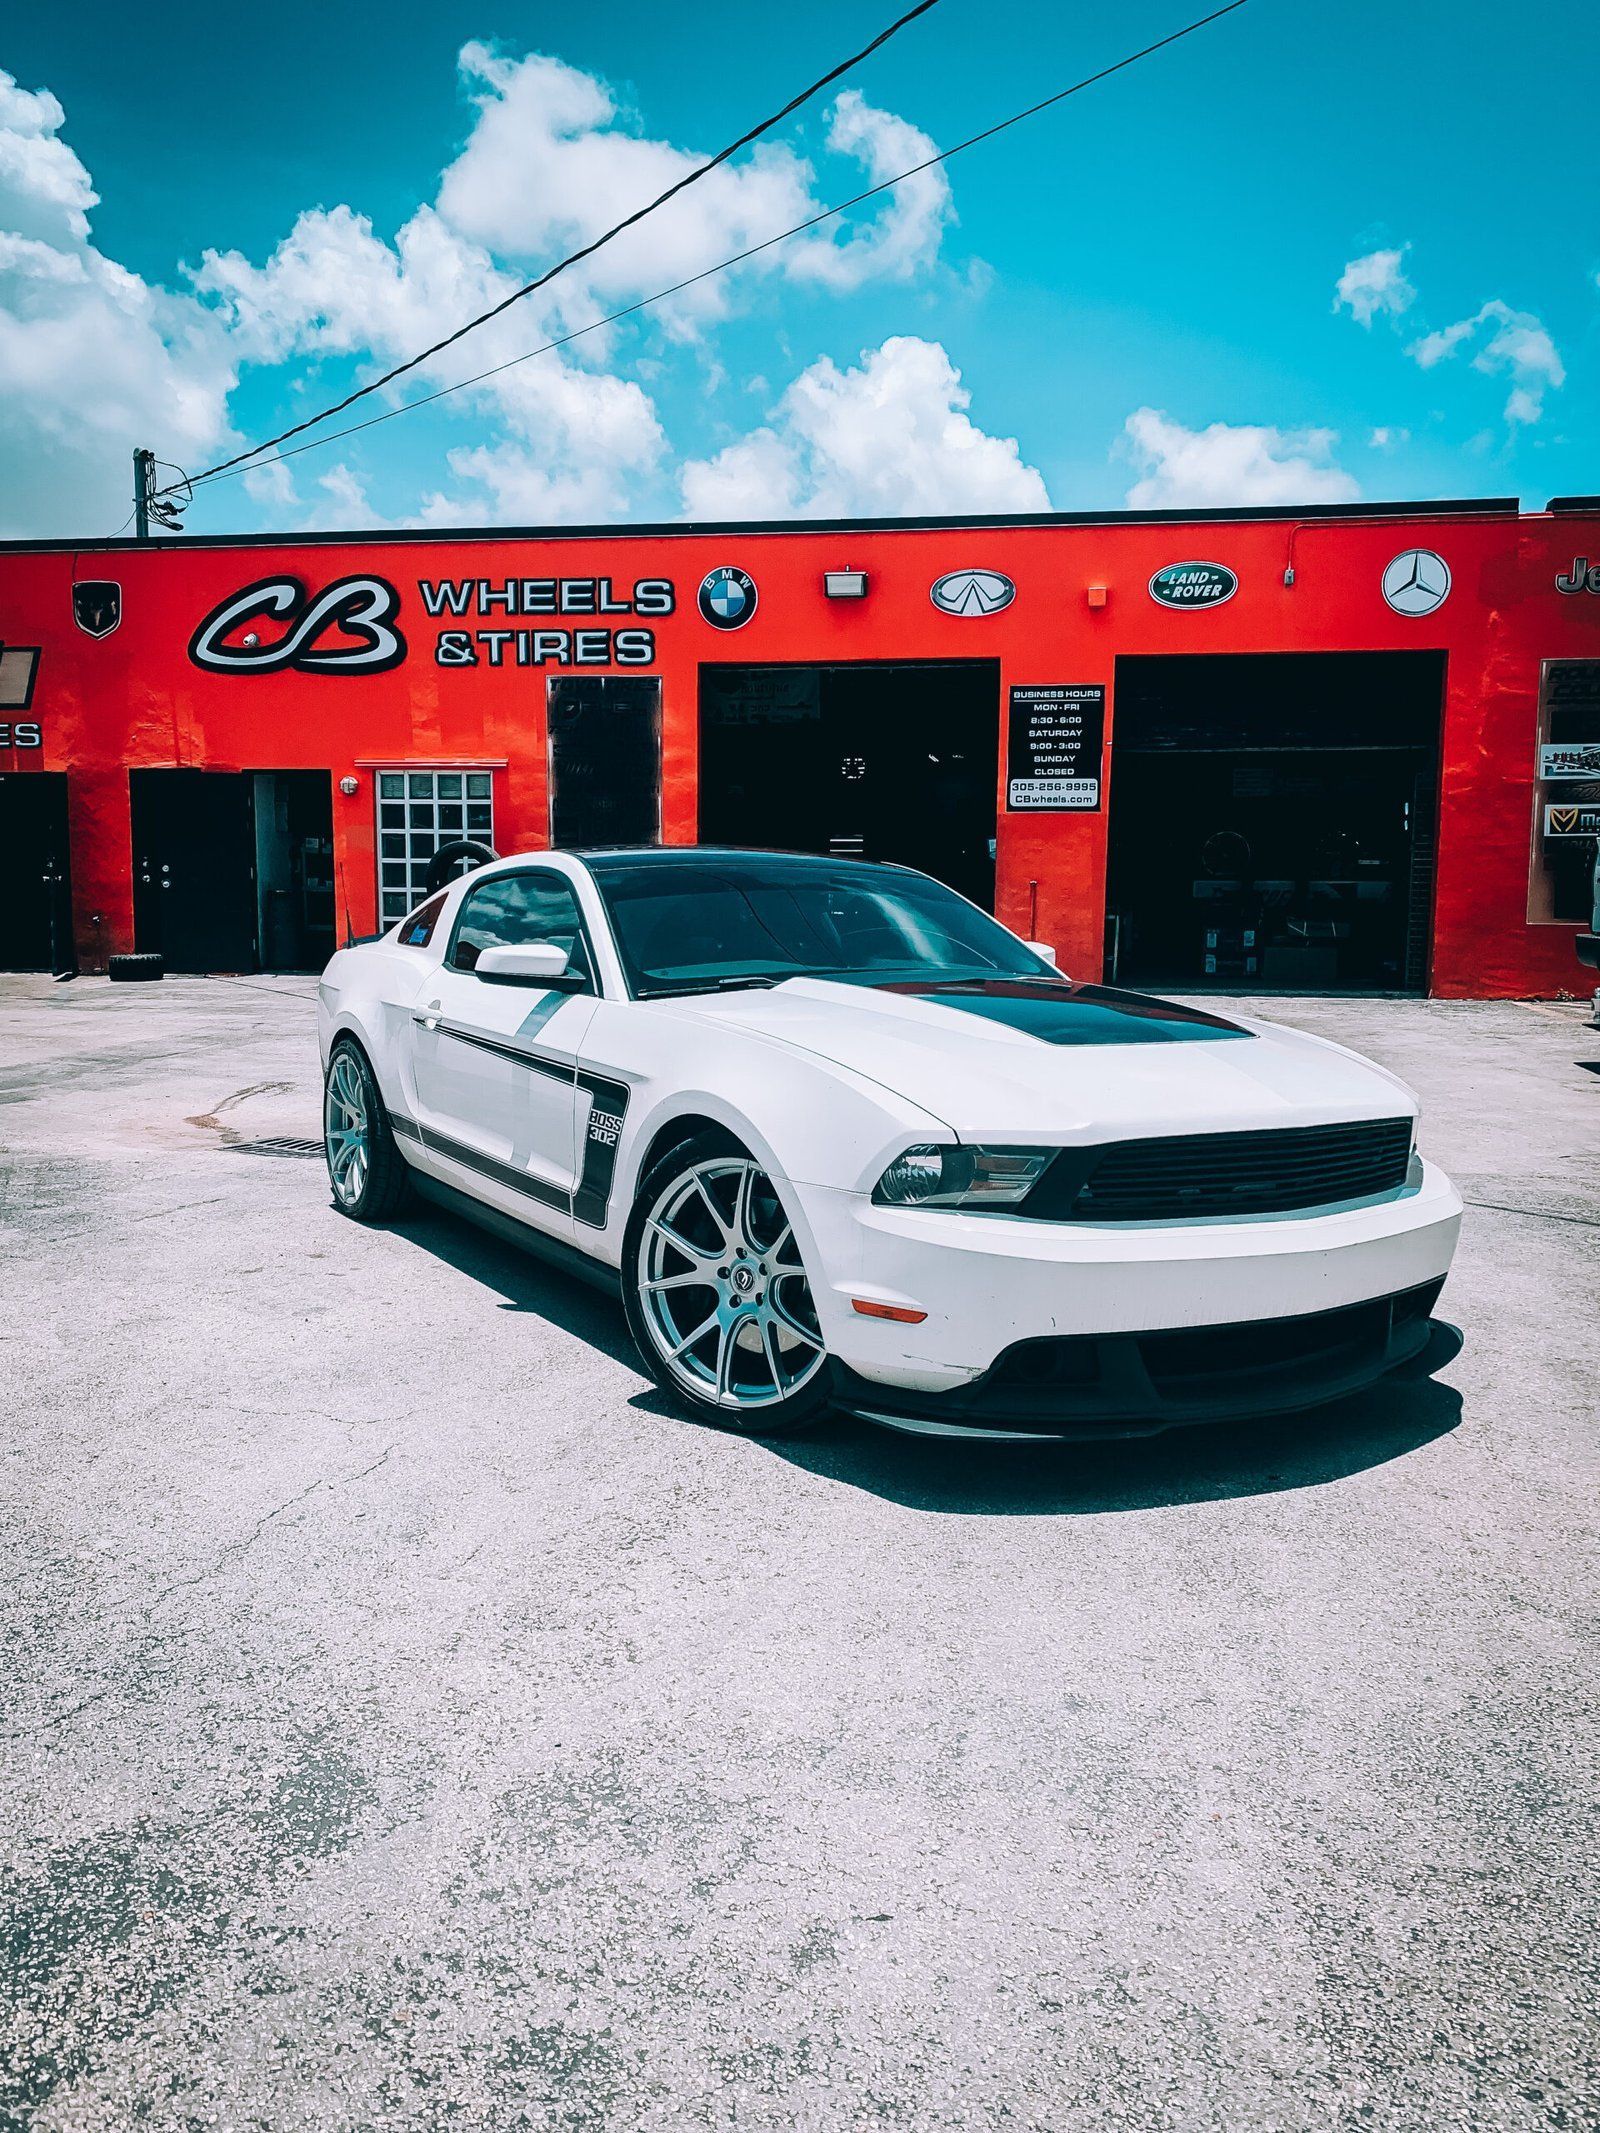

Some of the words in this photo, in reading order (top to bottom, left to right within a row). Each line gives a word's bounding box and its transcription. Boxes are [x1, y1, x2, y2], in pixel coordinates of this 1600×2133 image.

[703, 569, 752, 590] BMW
[419, 578, 675, 616] WHEELS
[188, 574, 407, 676] CB
[435, 628, 655, 666] &TIRES
[1065, 690, 1101, 698] HOURS
[1059, 716, 1082, 724] 6:00
[1034, 755, 1076, 763] SUNDAY
[1012, 783, 1097, 791] 305-256-9995
[1015, 795, 1092, 803] CBwheels.com
[589, 1110, 623, 1132] BOSS
[589, 1126, 616, 1147] 302
